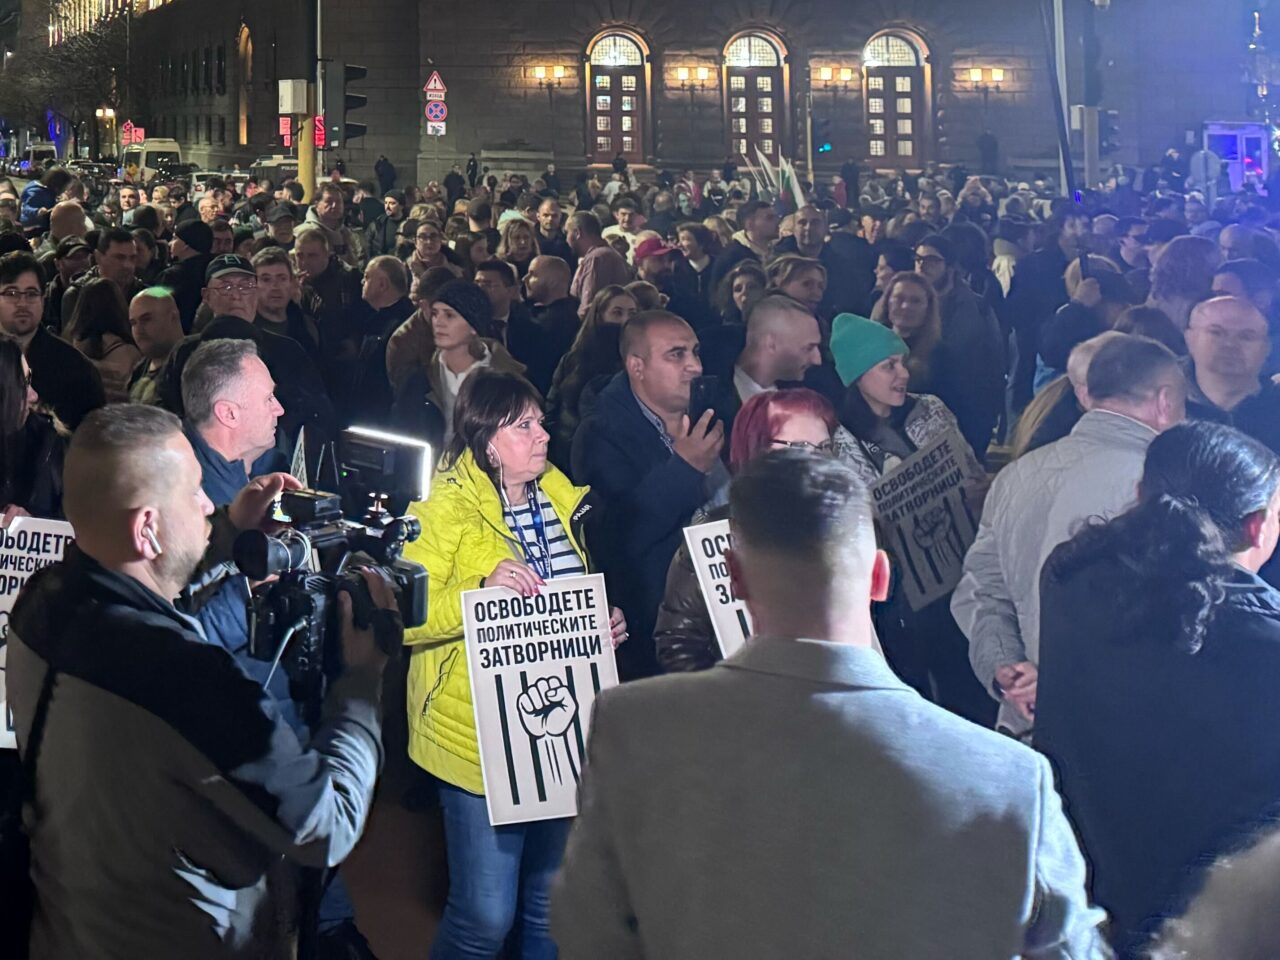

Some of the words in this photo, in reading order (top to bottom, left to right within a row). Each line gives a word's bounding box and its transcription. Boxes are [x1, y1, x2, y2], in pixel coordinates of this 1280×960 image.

[873, 440, 953, 501] ОСВОБОДЕТЕ
[474, 588, 596, 623] ОСВОБОДЕТЕ
[476, 614, 598, 644] ПОЛИТИЧЕСКИТЕ
[480, 634, 603, 669] ЗАТВОРНИЦИ
